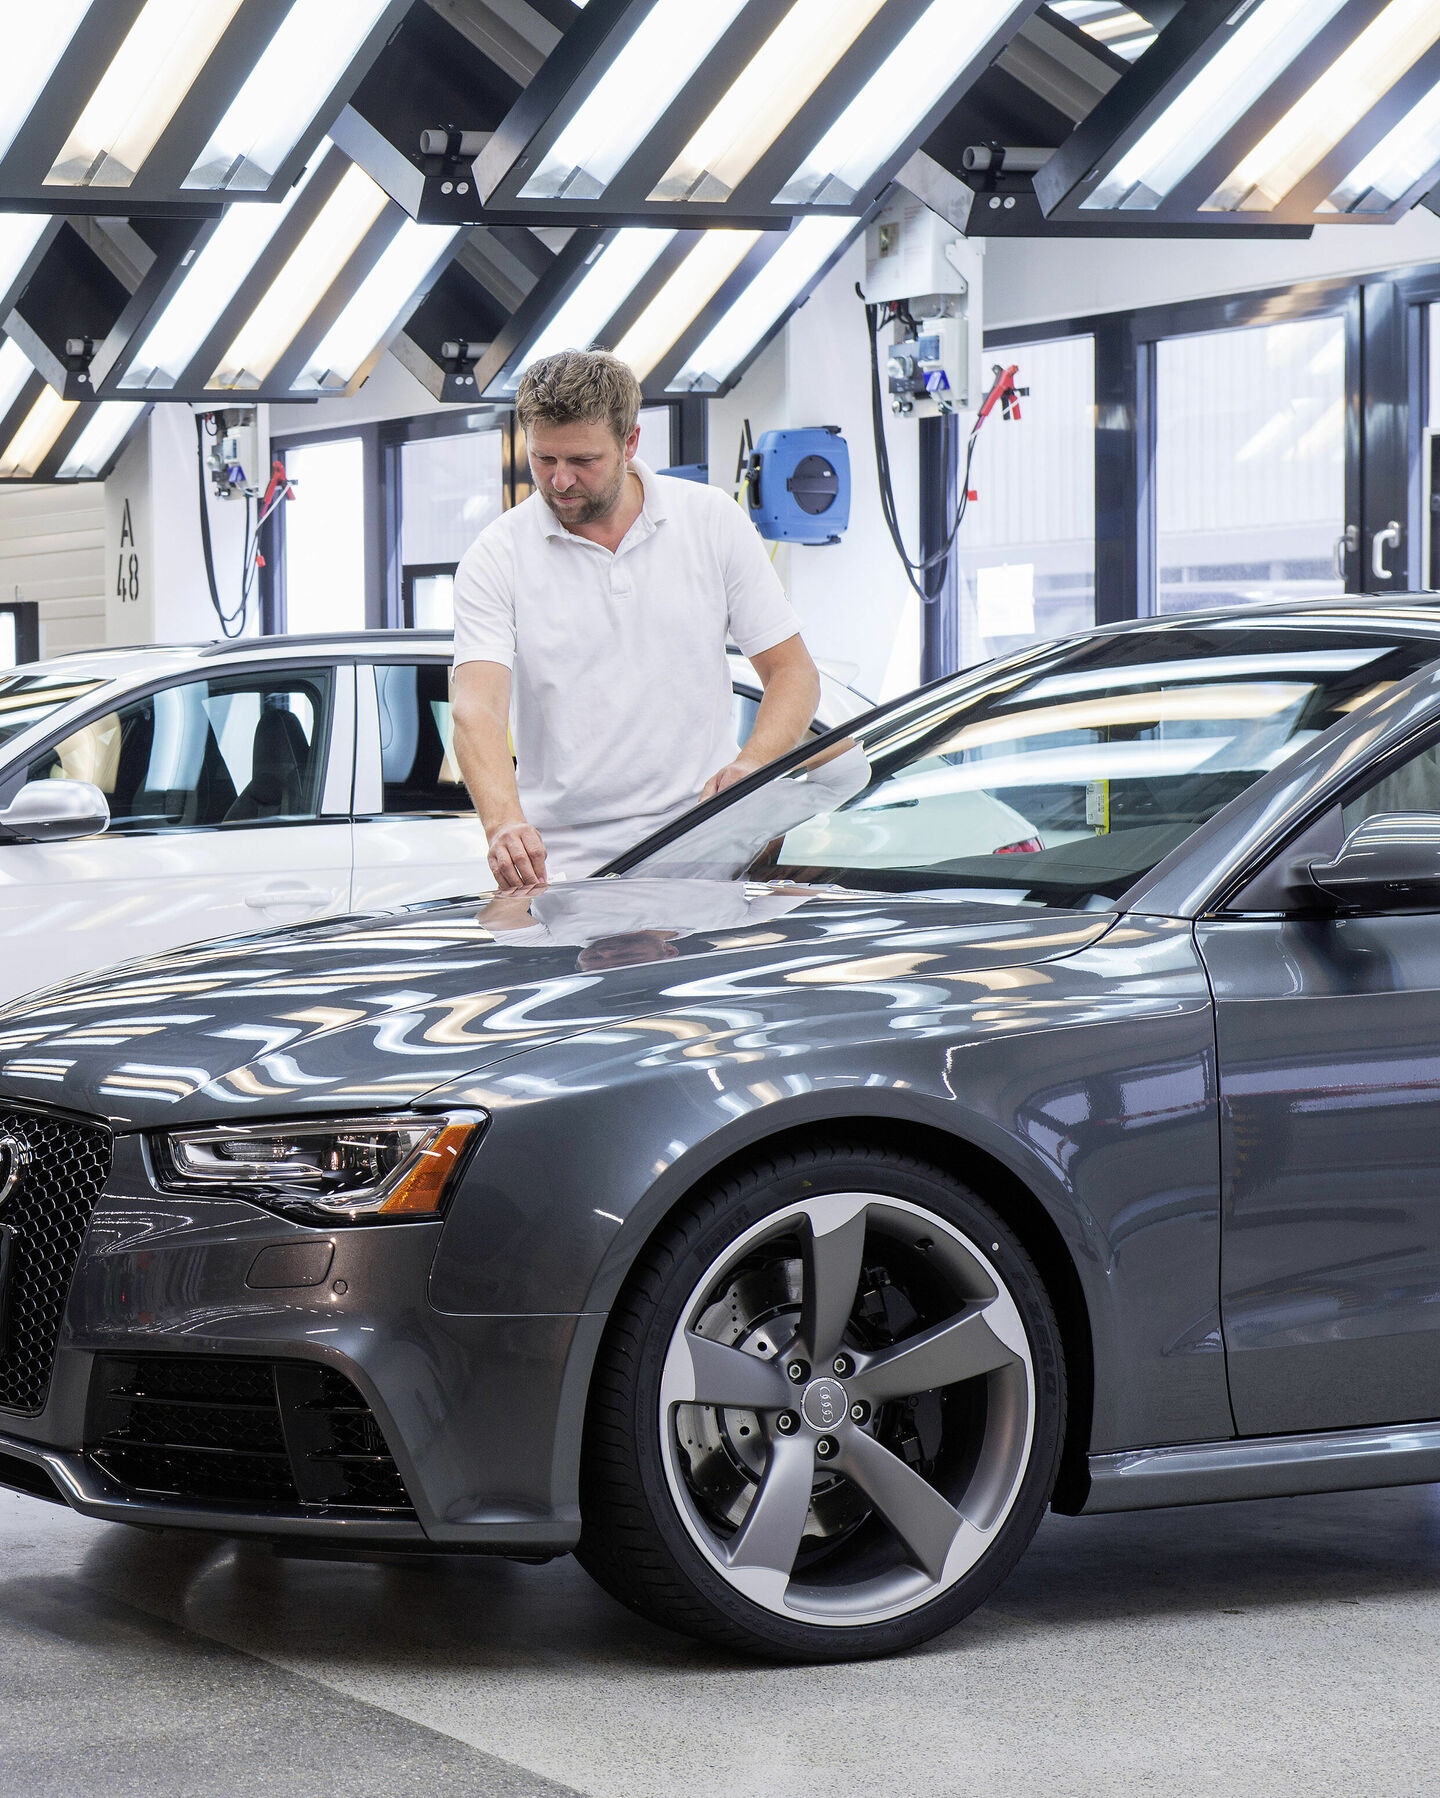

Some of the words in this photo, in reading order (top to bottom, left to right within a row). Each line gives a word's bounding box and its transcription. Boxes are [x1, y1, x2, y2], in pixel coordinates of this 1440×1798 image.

[734, 418, 754, 483] A
[120, 498, 134, 548] A
[117, 553, 139, 603] 48
